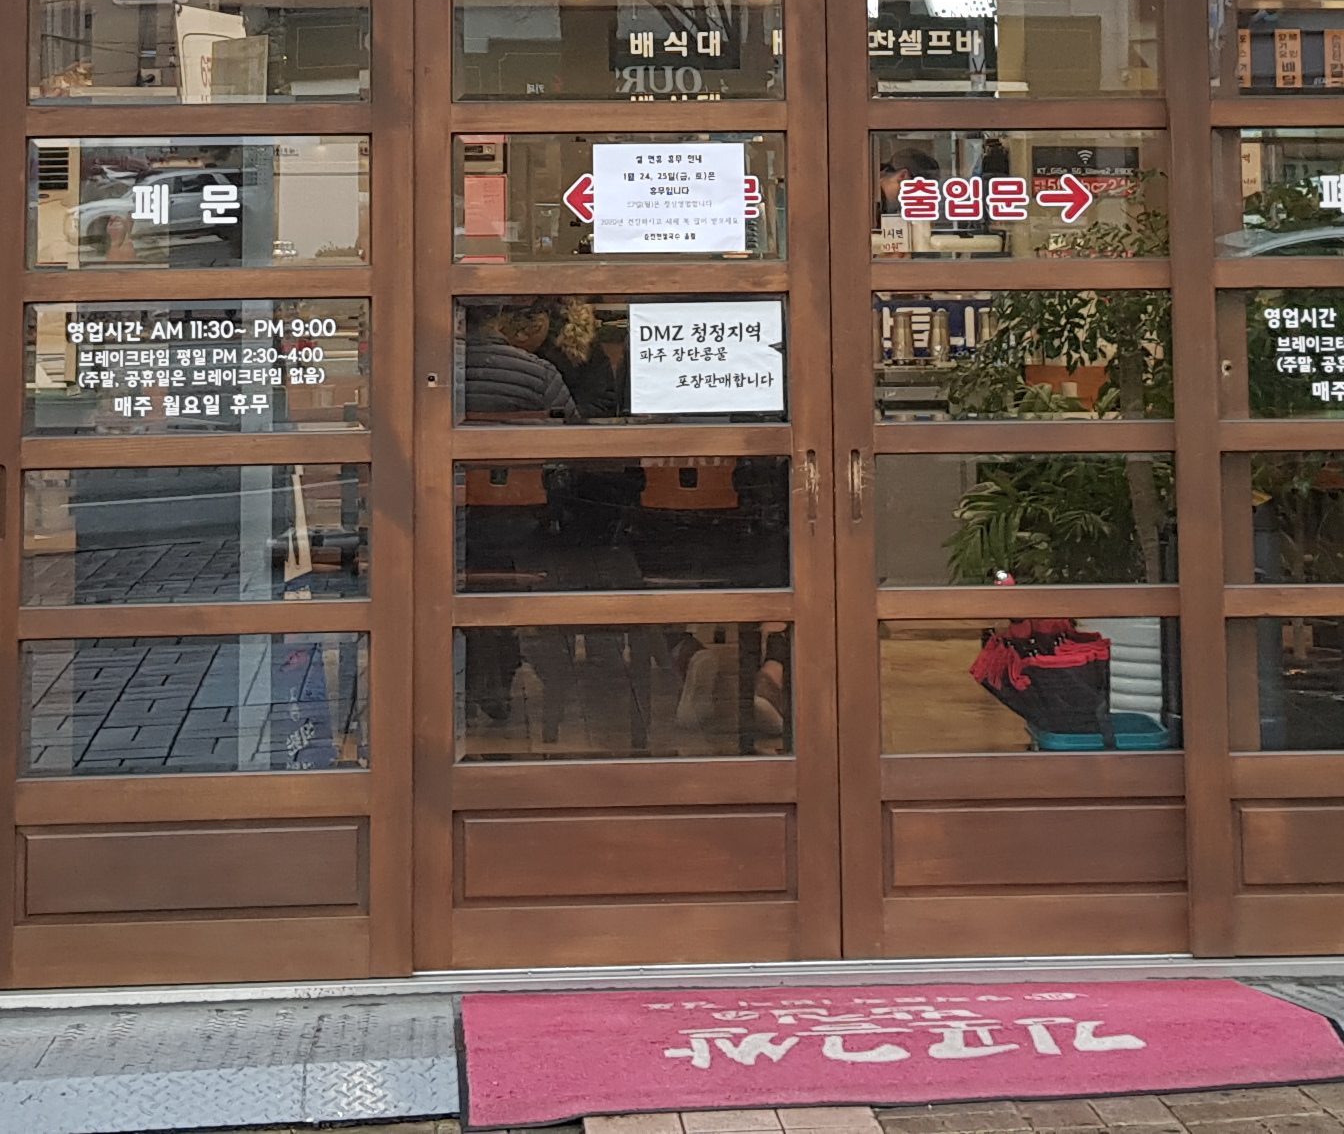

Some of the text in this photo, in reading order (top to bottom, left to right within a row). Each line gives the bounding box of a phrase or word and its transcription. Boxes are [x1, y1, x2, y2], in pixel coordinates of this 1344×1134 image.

[630, 31, 720, 57] 배식대
[899, 177, 1029, 221] 출입문
[1264, 308, 1337, 328] 영업시간
[67, 321, 143, 343] 영업시간
[151, 323, 183, 339] AM
[254, 320, 284, 337] PM
[291, 319, 336, 337] 9:00
[640, 322, 761, 342] DMZ 청정지역
[79, 347, 324, 367] 브레이크타임 평일 PM 2:30~4:00
[639, 348, 667, 362] 파주
[125, 370, 186, 387] 공휴일은
[192, 368, 282, 386] 브레이크타임
[289, 367, 325, 385] 없음)
[676, 372, 774, 388] 포장판매합니다
[114, 394, 269, 417] 매주 월요일 휴무
